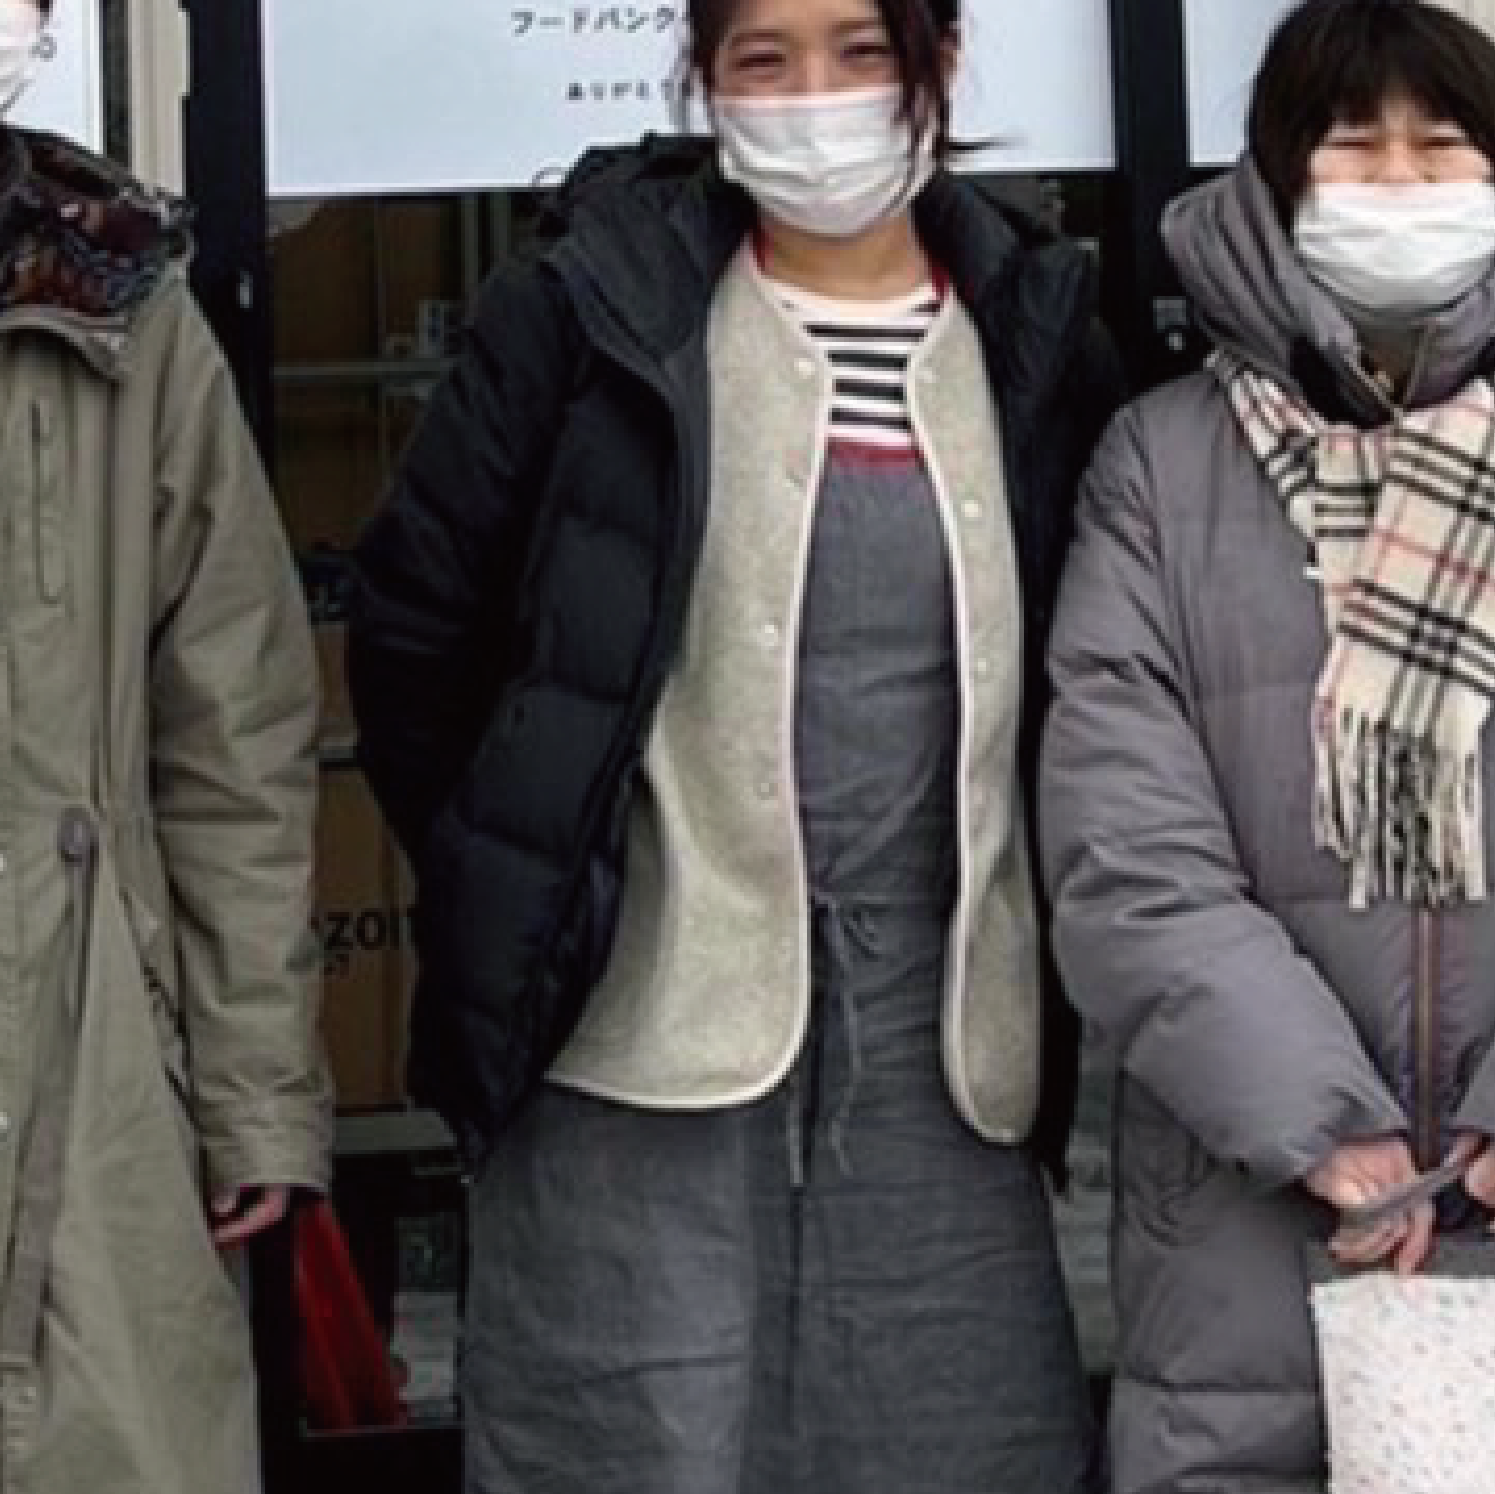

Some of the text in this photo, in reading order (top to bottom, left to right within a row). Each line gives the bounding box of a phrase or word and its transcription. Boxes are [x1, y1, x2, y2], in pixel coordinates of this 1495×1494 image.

[511, 5, 689, 36] フードバンク
